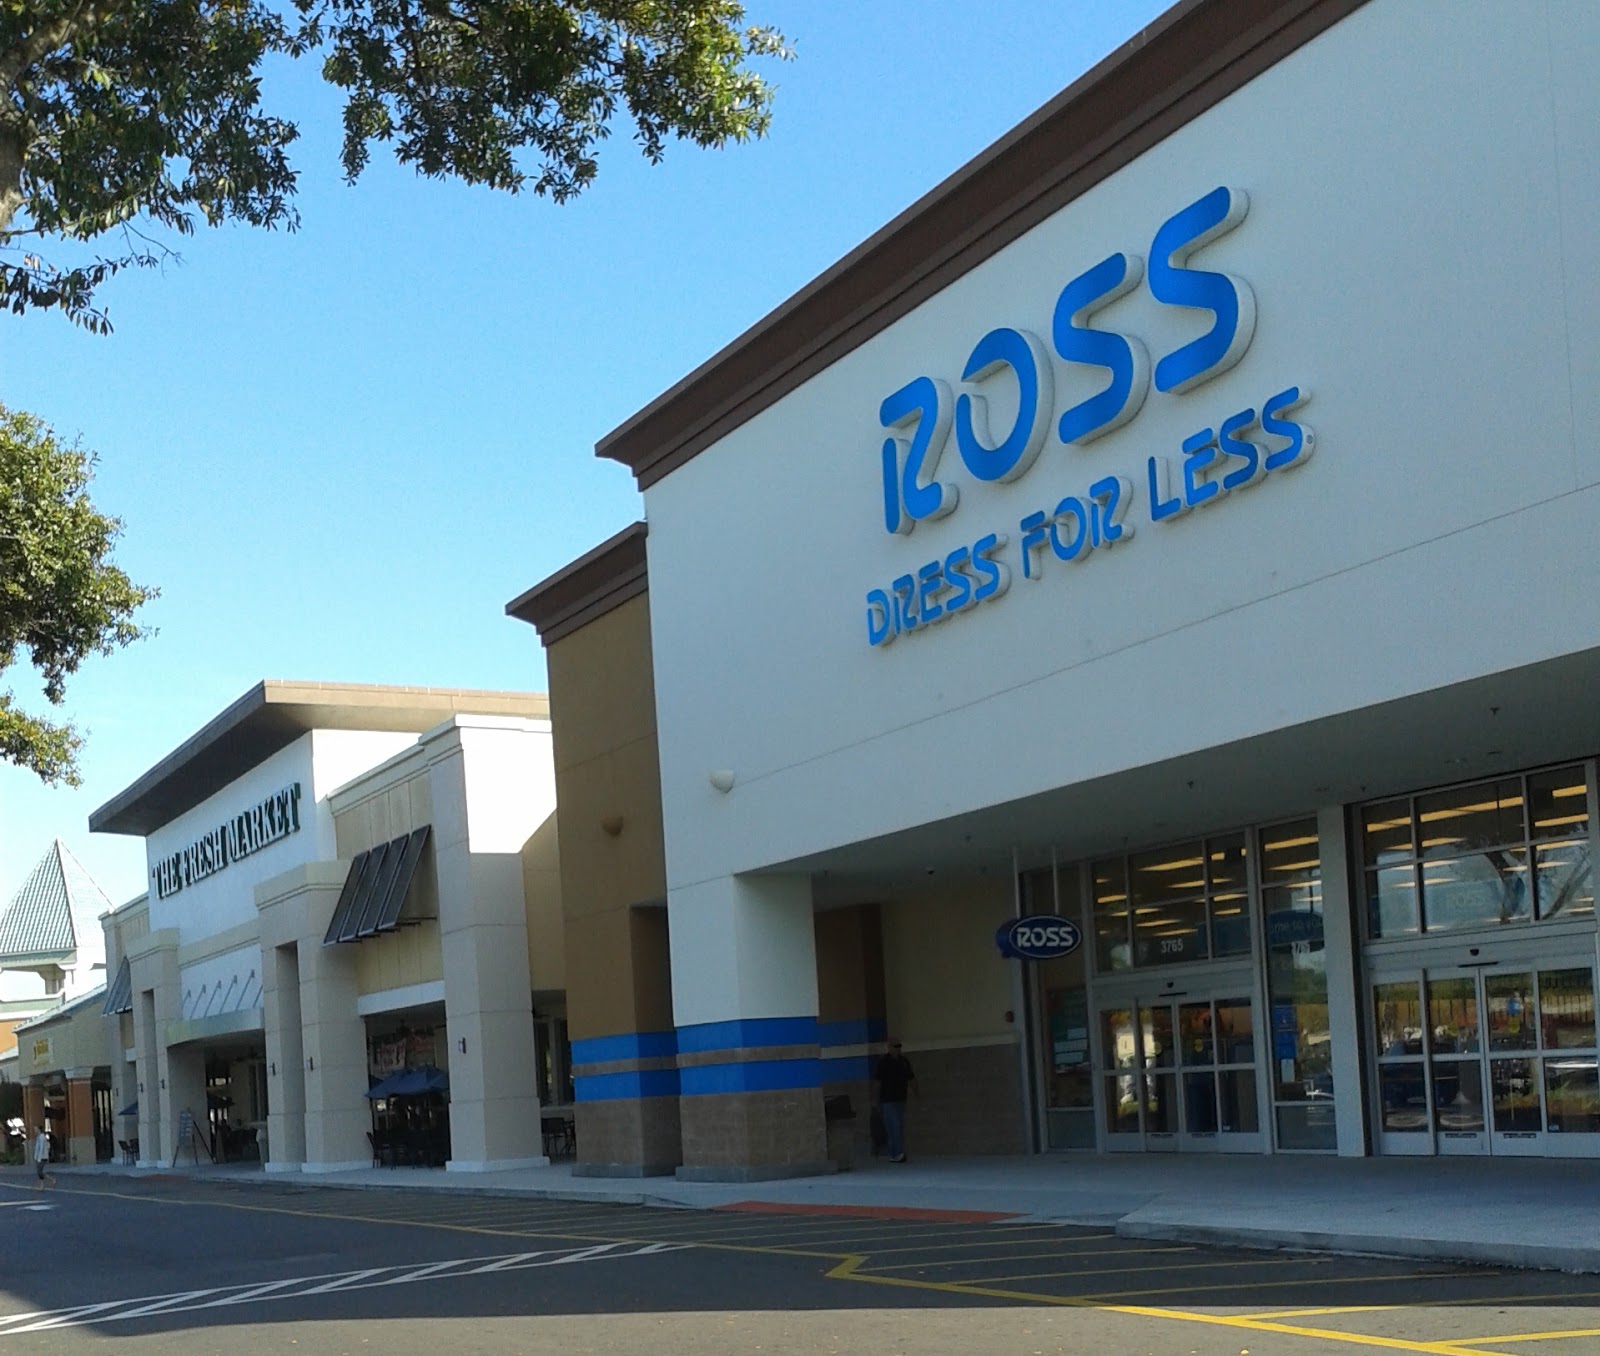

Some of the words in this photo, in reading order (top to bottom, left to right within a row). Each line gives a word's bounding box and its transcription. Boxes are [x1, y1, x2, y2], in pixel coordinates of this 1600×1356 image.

[879, 186, 1254, 536] ROSS
[866, 533, 1008, 646] DRESS
[1020, 476, 1132, 579] FOR
[1148, 386, 1314, 521] LESS
[152, 852, 182, 899] THE
[182, 825, 229, 887] FRESH
[226, 782, 301, 863] MARKET
[1016, 926, 1074, 948] ROSS
[1160, 938, 1184, 954] 3765
